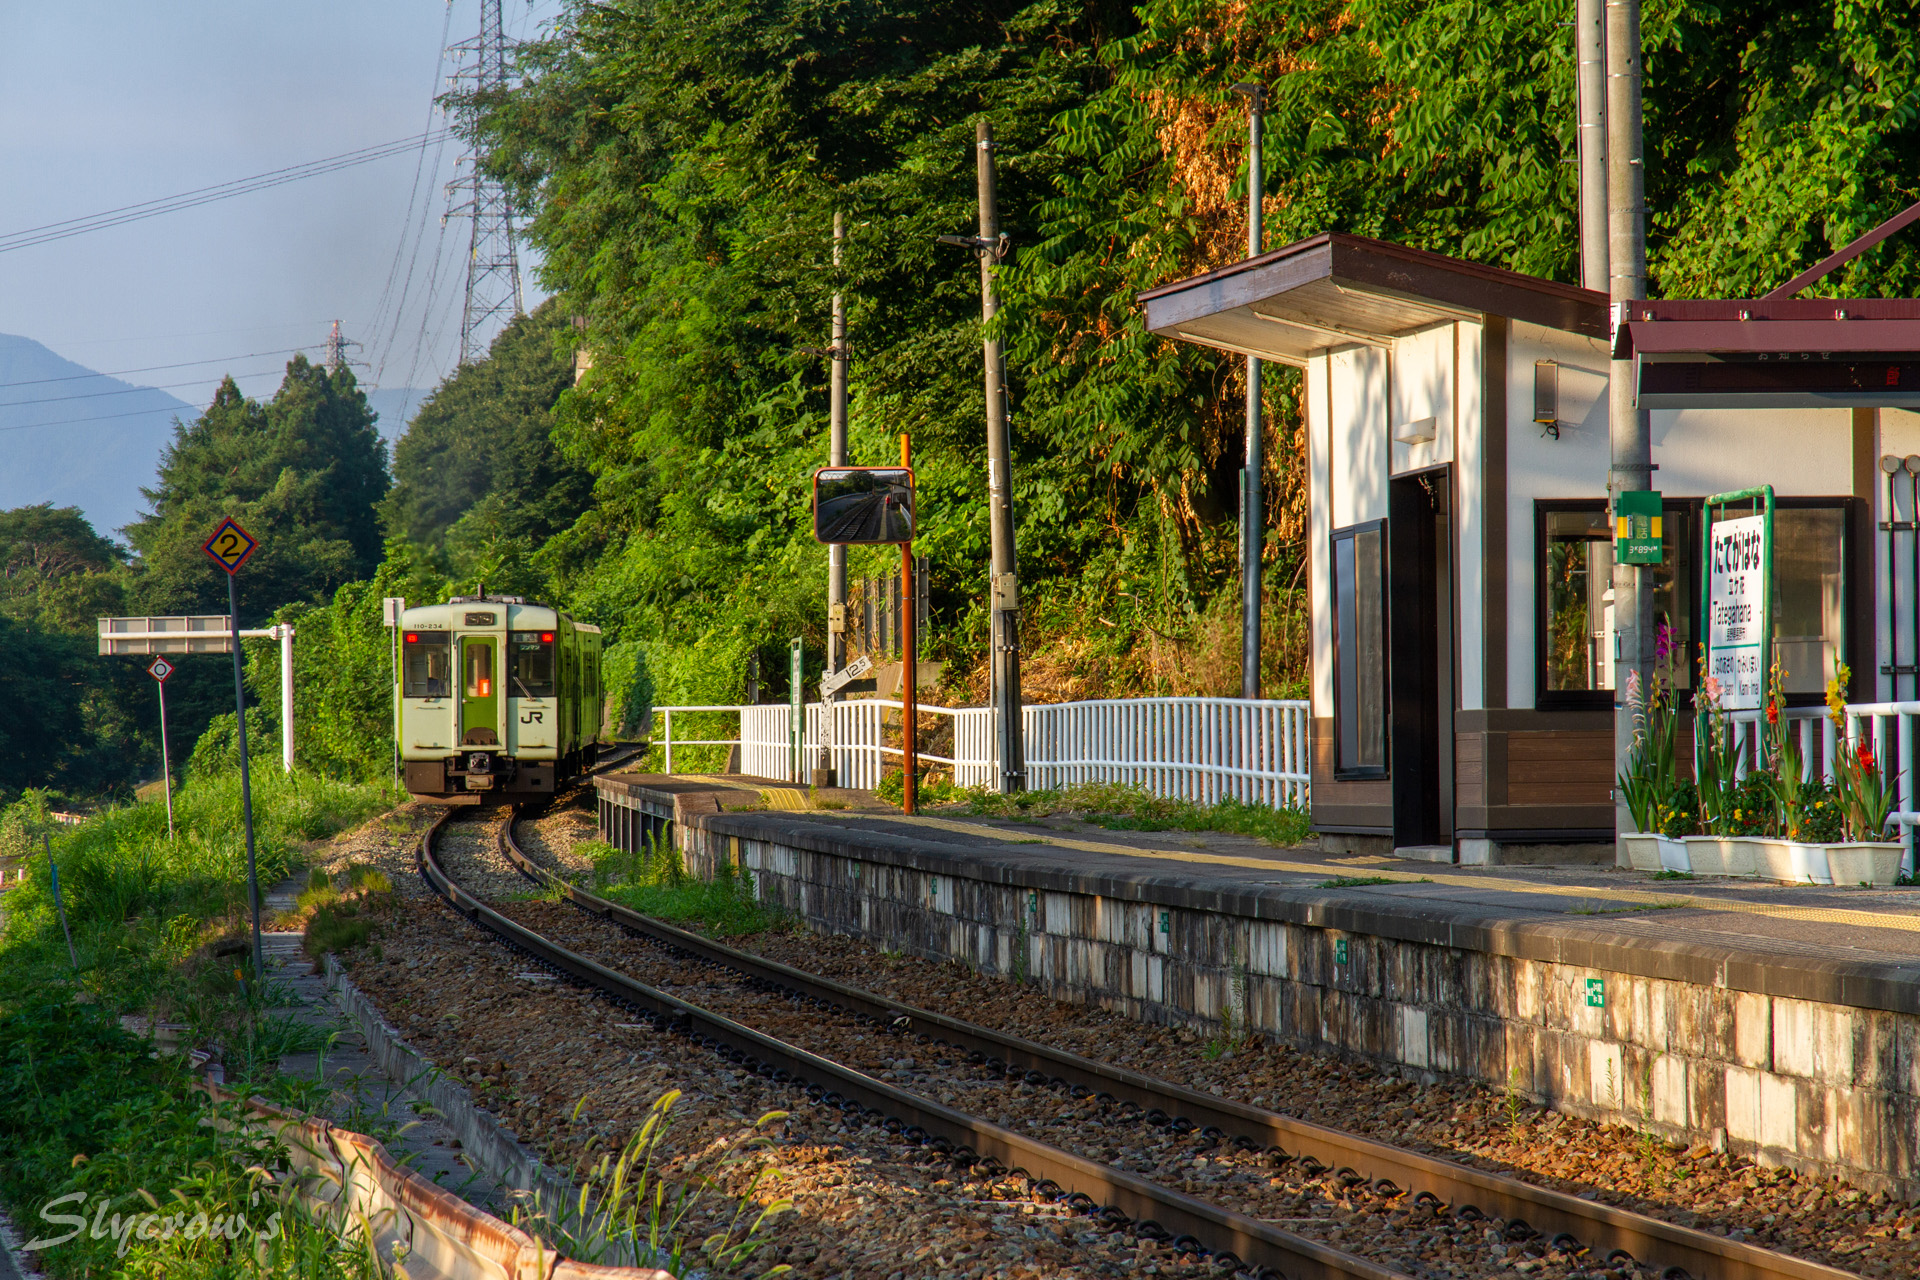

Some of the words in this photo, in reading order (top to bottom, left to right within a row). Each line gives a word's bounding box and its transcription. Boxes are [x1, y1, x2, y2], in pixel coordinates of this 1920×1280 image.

[220, 534, 240, 557] 2
[1713, 530, 1761, 574] たてがはな
[1713, 599, 1752, 626] Tategahana
[521, 711, 543, 724] JR
